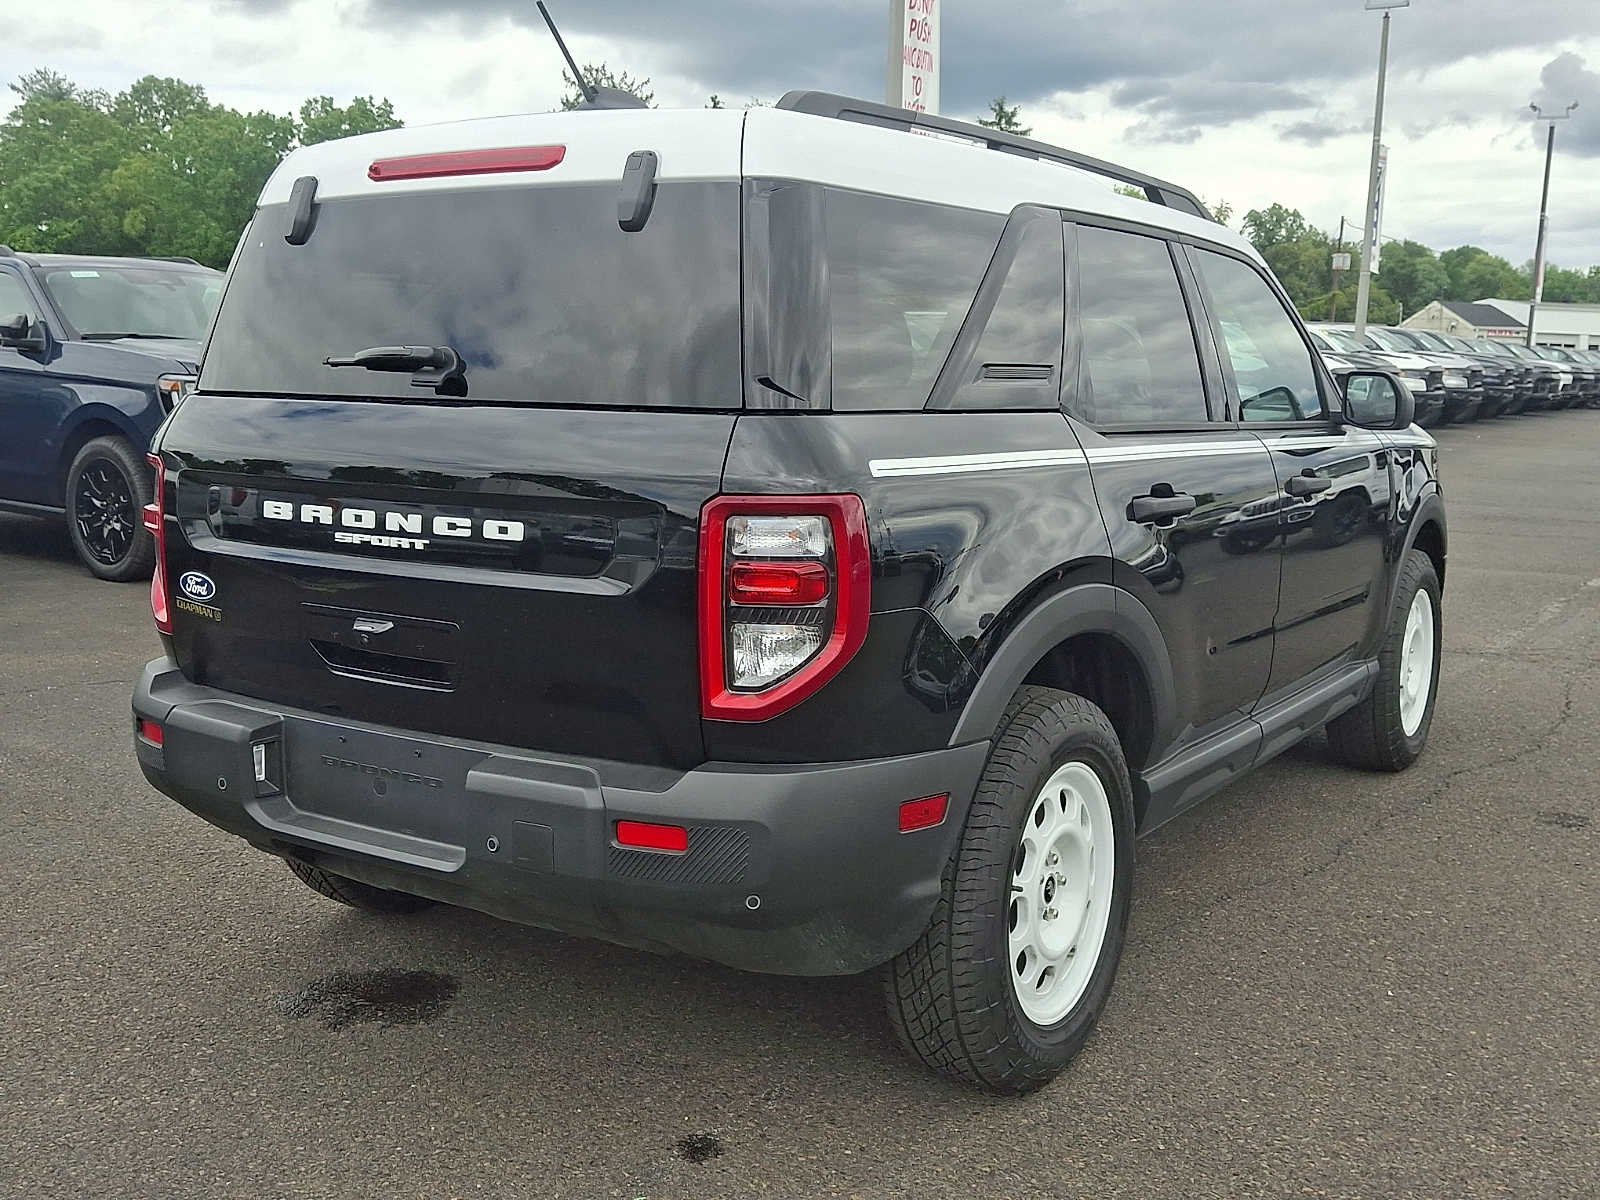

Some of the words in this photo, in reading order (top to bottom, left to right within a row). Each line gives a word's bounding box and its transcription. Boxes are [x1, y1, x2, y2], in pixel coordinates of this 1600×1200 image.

[908, 18, 932, 44] PUSH
[911, 75, 922, 96] TO
[263, 500, 525, 542] BRONCO
[334, 532, 430, 550] SPORT
[176, 599, 213, 618] CHAPMAN
